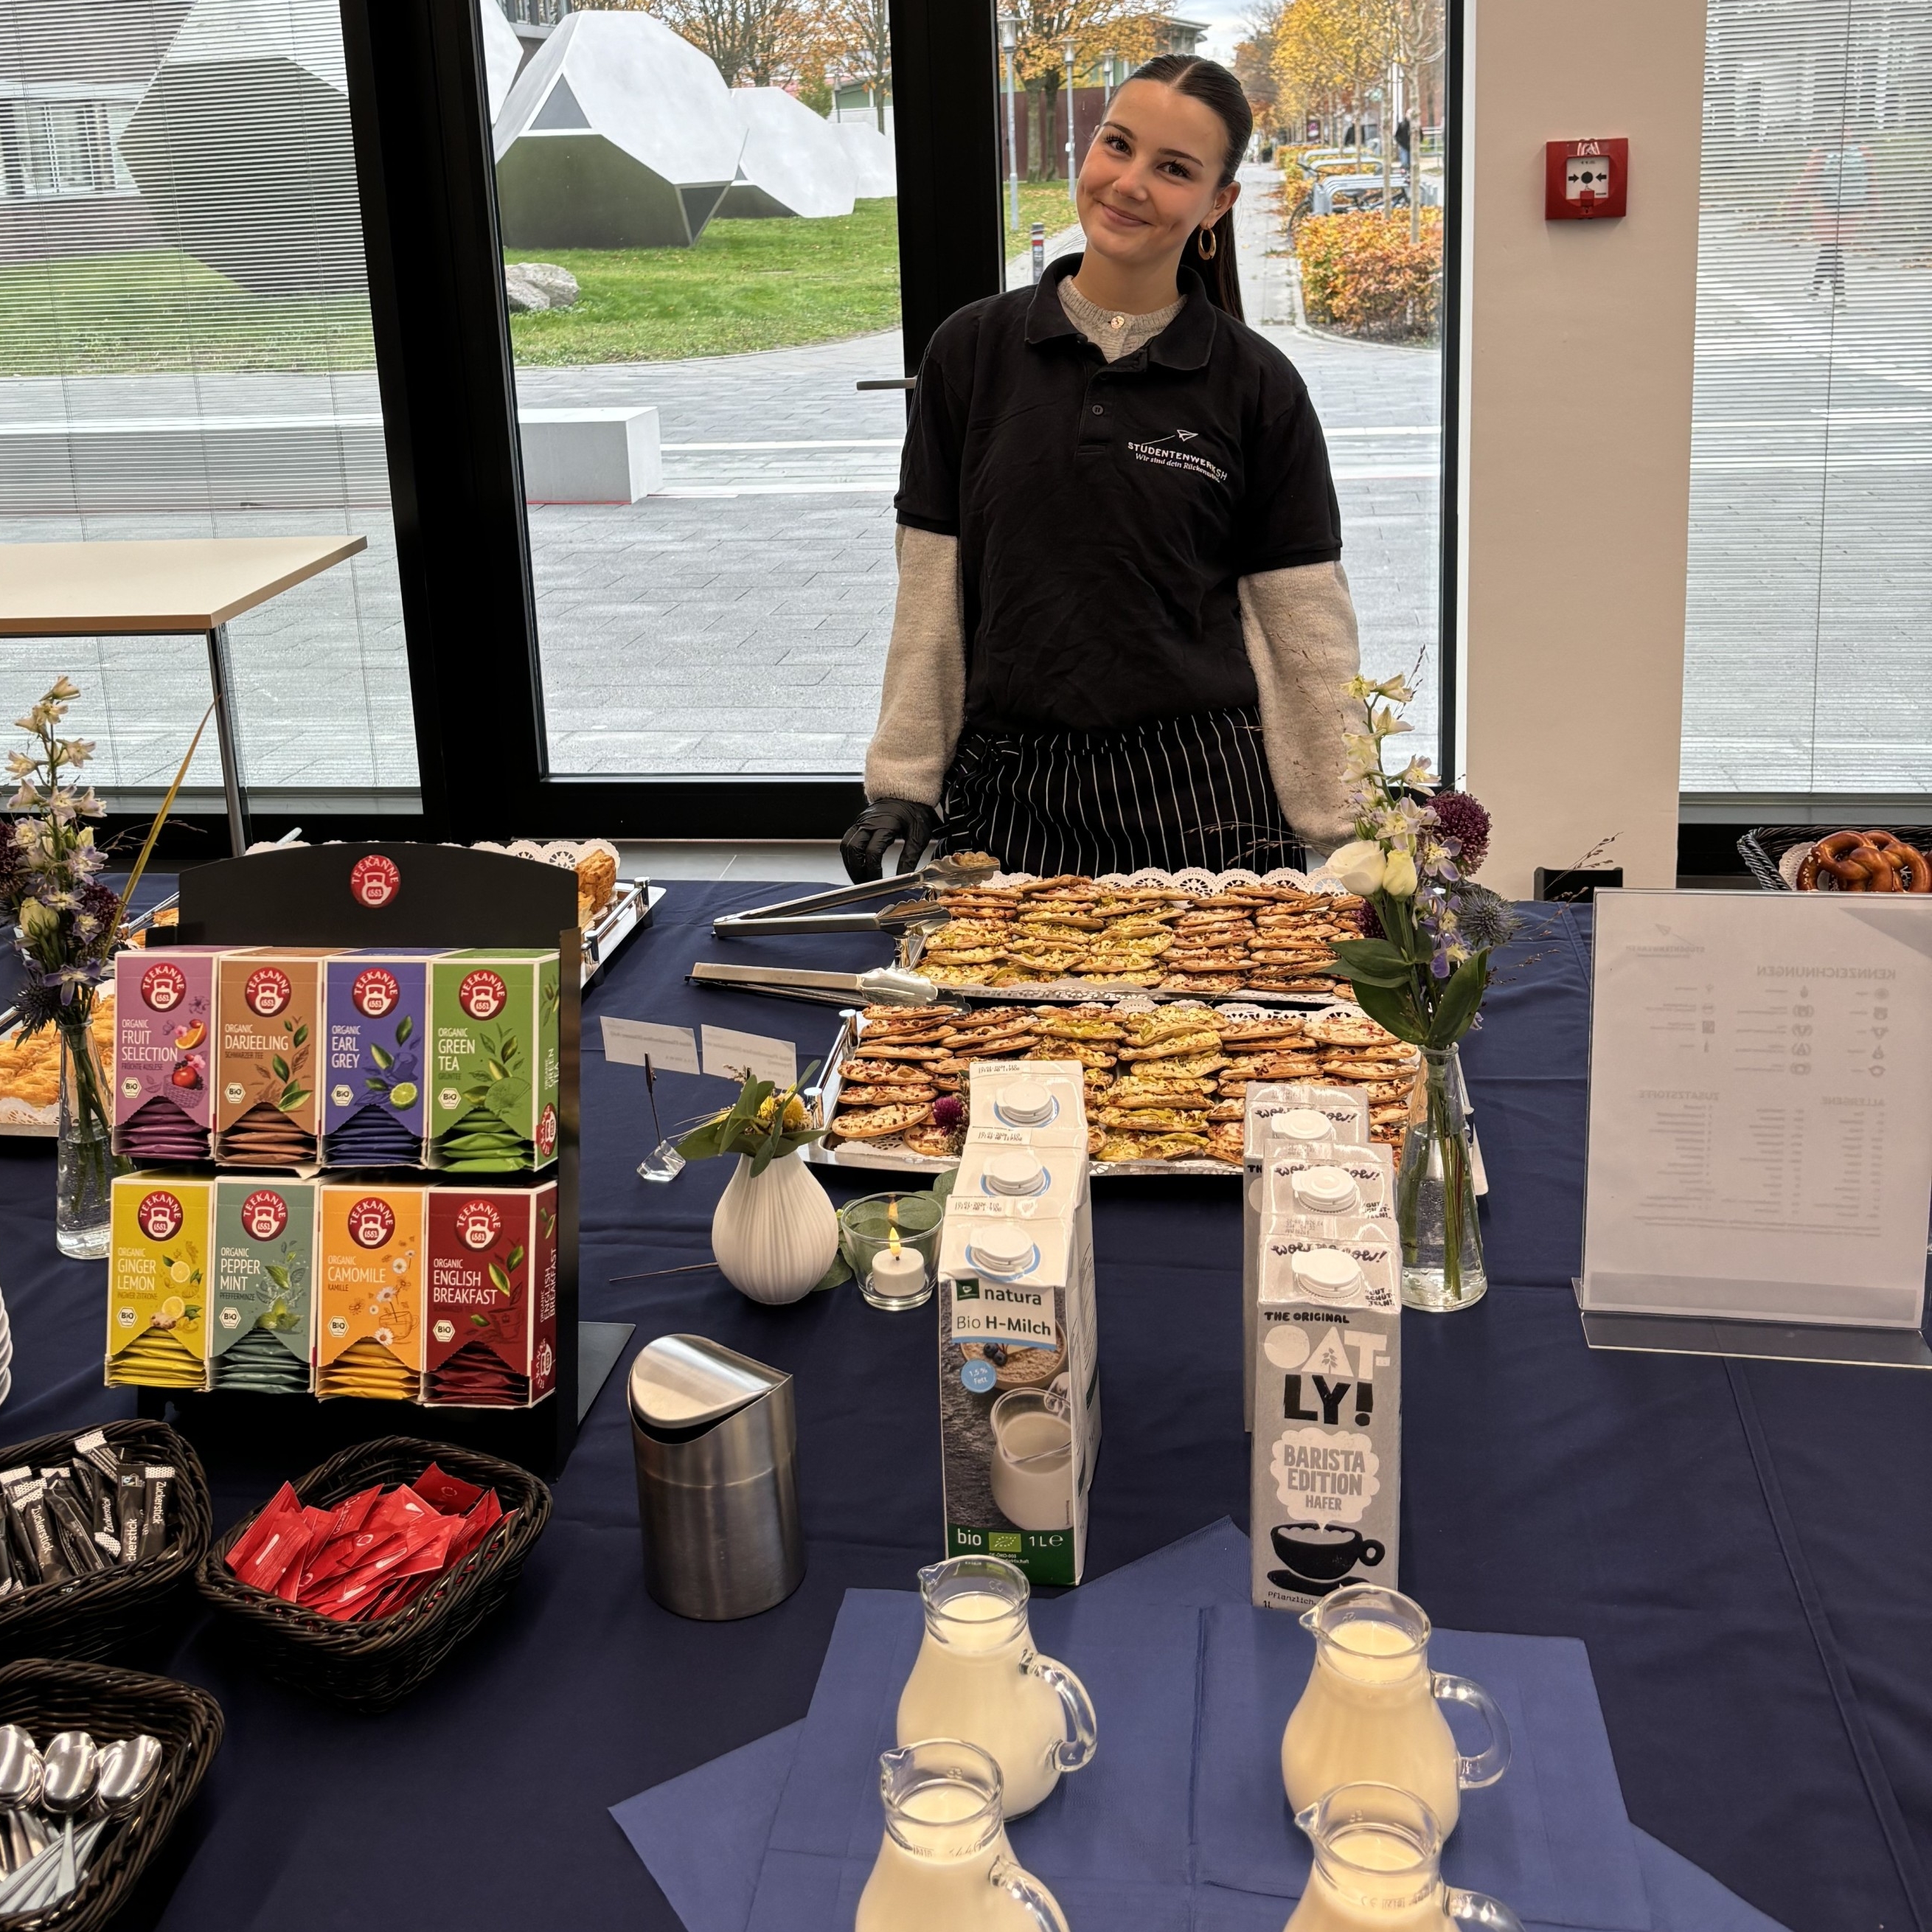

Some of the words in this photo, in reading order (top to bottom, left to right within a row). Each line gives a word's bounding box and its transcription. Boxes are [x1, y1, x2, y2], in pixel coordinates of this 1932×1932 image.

[1136, 453, 1150, 462] Wir
[1167, 460, 1182, 468] dein
[351, 856, 399, 884] TEEKANNE
[142, 965, 184, 990] TEEKANNE
[246, 970, 290, 995] TEEKANNE
[354, 970, 398, 995] TEEKANNE
[461, 973, 505, 998] TEEKANNE
[122, 1019, 149, 1029] ORGANIC
[225, 1024, 253, 1033] ORGANIC
[332, 1025, 361, 1035] ORGANIC
[438, 1027, 468, 1037] ORGANIC
[122, 1030, 151, 1045] FRUIT
[225, 1035, 288, 1050] DARJEELING
[332, 1036, 359, 1052] EARL
[122, 1046, 178, 1062] SELECTION
[438, 1039, 475, 1054] GREEN
[332, 1053, 360, 1068] GREY
[438, 1056, 459, 1071] TEA
[1247, 1164, 1262, 1173] TH
[139, 1194, 181, 1219] TEEKANNE
[243, 1193, 286, 1217] TEEKANNE
[350, 1200, 393, 1226] TEEKANNE
[456, 1203, 501, 1229] TEEKANNE
[118, 1247, 146, 1257] ORGANIC
[221, 1247, 249, 1257] ORGANIC
[328, 1255, 356, 1265] ORGANIC
[118, 1258, 156, 1274] GINGER
[221, 1258, 260, 1274] PEPPER
[434, 1258, 463, 1269] ORGANIC
[117, 1275, 155, 1290] LEMON
[220, 1275, 248, 1290] MINT
[328, 1266, 386, 1283] CAMOMILE
[434, 1270, 481, 1286] ENGLISH
[328, 1284, 349, 1292] KAMILLE
[434, 1288, 498, 1304] BREAKFAST
[220, 1292, 255, 1301] PFEFFERMINZE
[984, 1288, 1042, 1305] natura
[957, 1316, 981, 1329] Bio
[986, 1316, 1051, 1335] H-Milch
[1265, 1312, 1290, 1321] THE
[1293, 1312, 1349, 1324] ORIGINAL
[1284, 1374, 1374, 1426] LY!
[1284, 1444, 1366, 1473] BARISTA
[1288, 1467, 1363, 1495] EDITION
[153, 1481, 167, 1524] Zuckerstick
[1305, 1495, 1342, 1511] HAFER
[102, 1496, 115, 1533] Zuckerstick
[31, 1505, 54, 1554] Zuckerstick
[958, 1528, 981, 1546] bio
